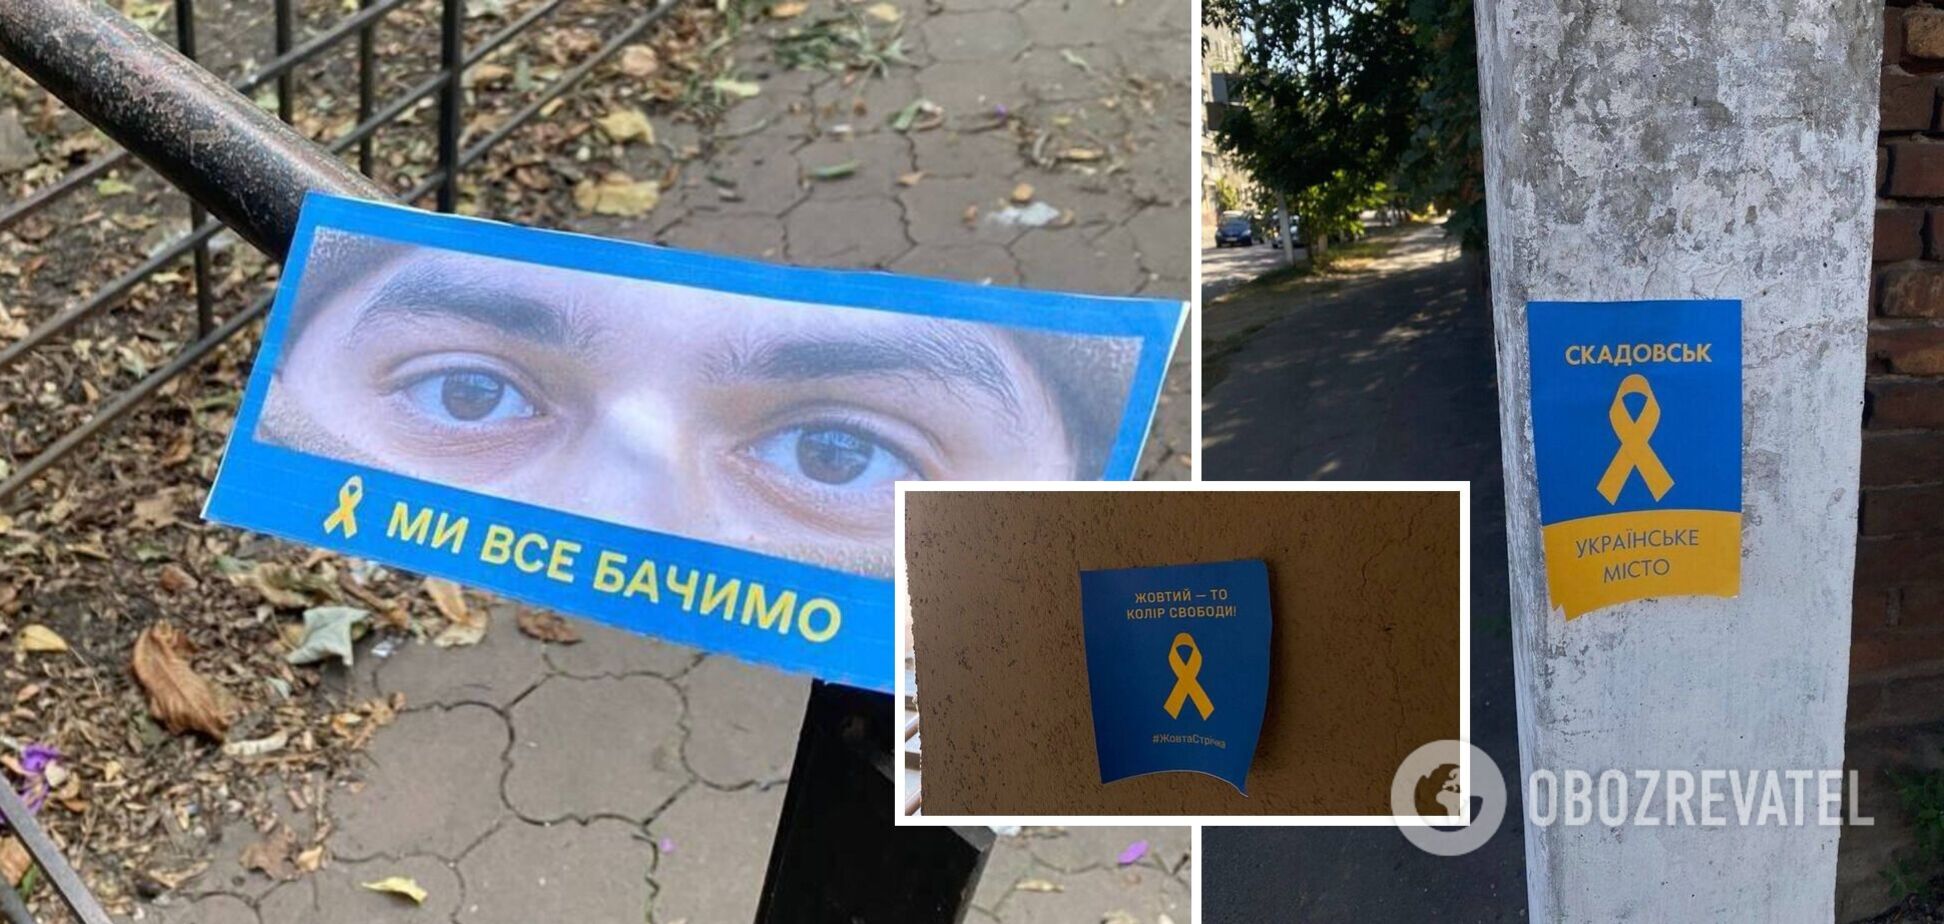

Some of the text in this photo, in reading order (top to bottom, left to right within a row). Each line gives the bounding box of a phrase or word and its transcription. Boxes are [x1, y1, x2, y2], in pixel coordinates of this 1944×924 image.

[1565, 343, 1712, 366] СКАДОВСЬК
[1576, 527, 1699, 558] УКРАЇНСЬКЕ
[386, 501, 841, 643] МИ ВСЕ БАЧИМО
[1603, 558, 1670, 583] МІСТО
[1135, 588, 1191, 604] ЖОВТИЙ
[1210, 589, 1228, 600] ТО
[1127, 606, 1236, 620] КОЛІР СВОБОДИ!
